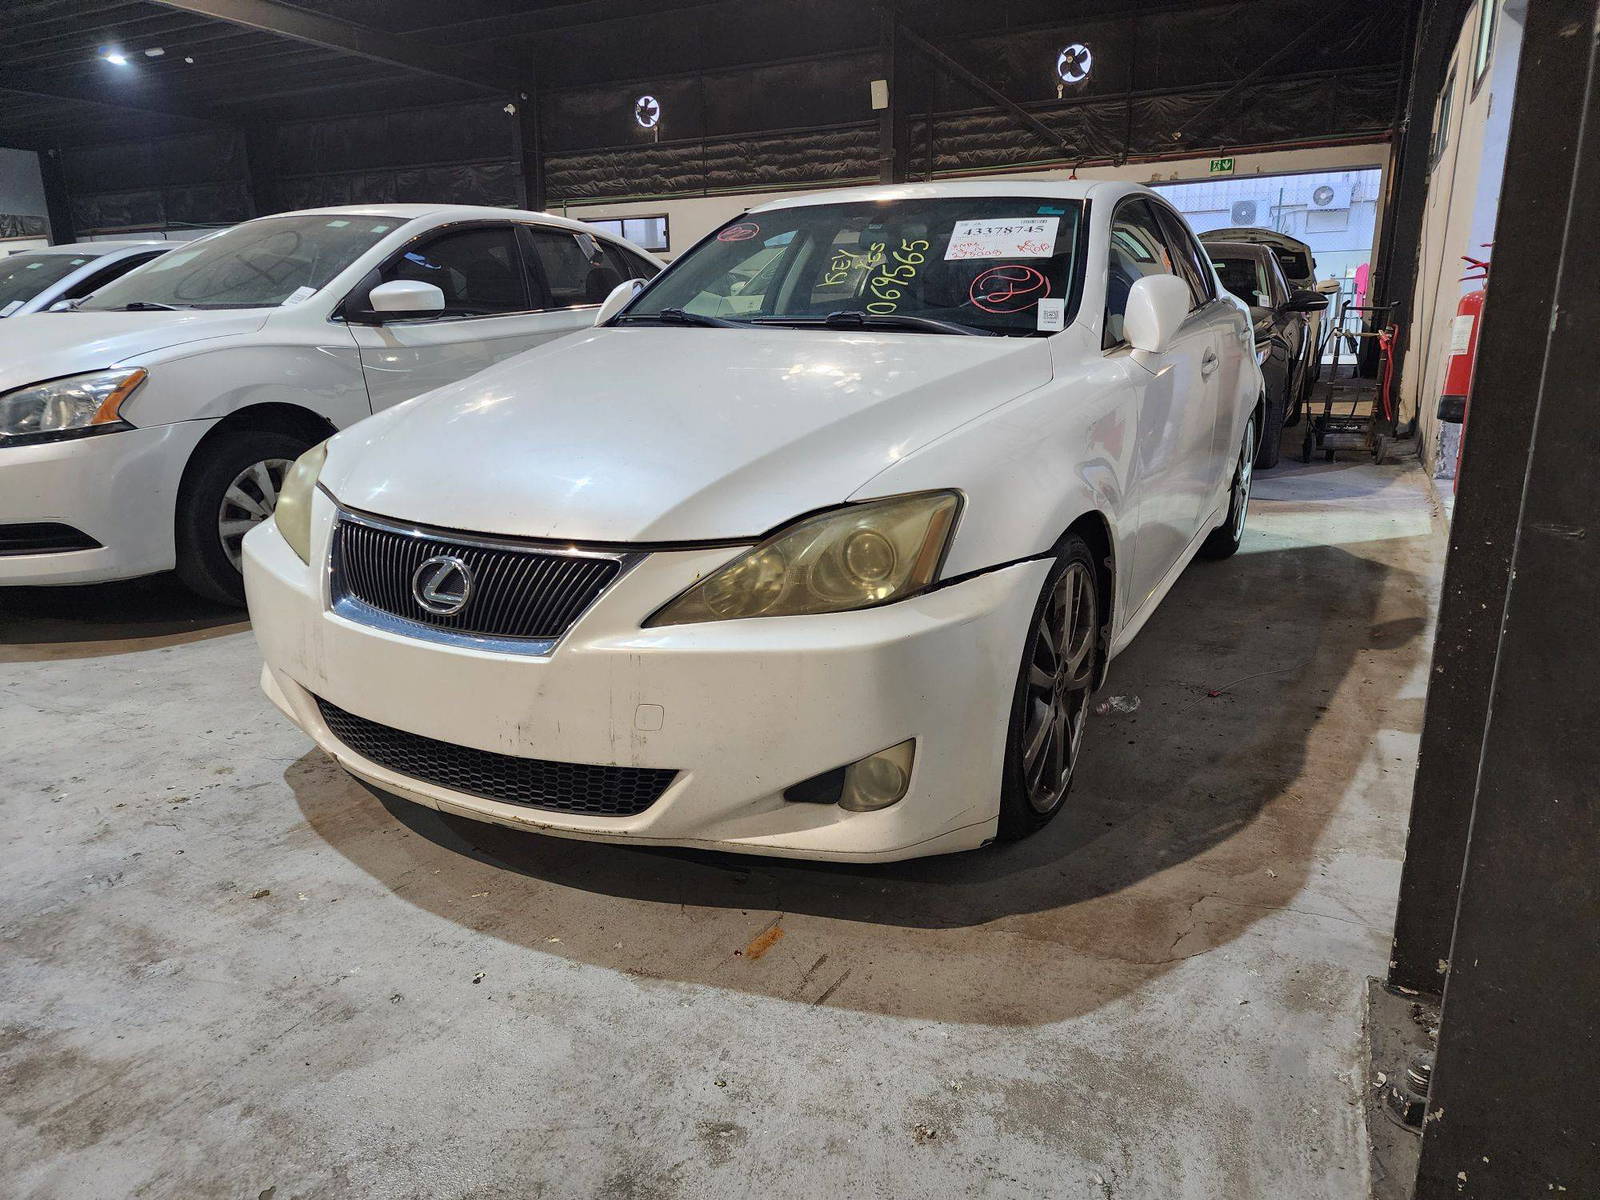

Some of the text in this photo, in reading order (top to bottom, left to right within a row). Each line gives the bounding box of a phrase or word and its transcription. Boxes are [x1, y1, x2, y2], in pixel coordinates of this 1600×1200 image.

[963, 225, 1045, 236] 43378745
[816, 249, 861, 288] KEY
[866, 238, 930, 315] 069565
